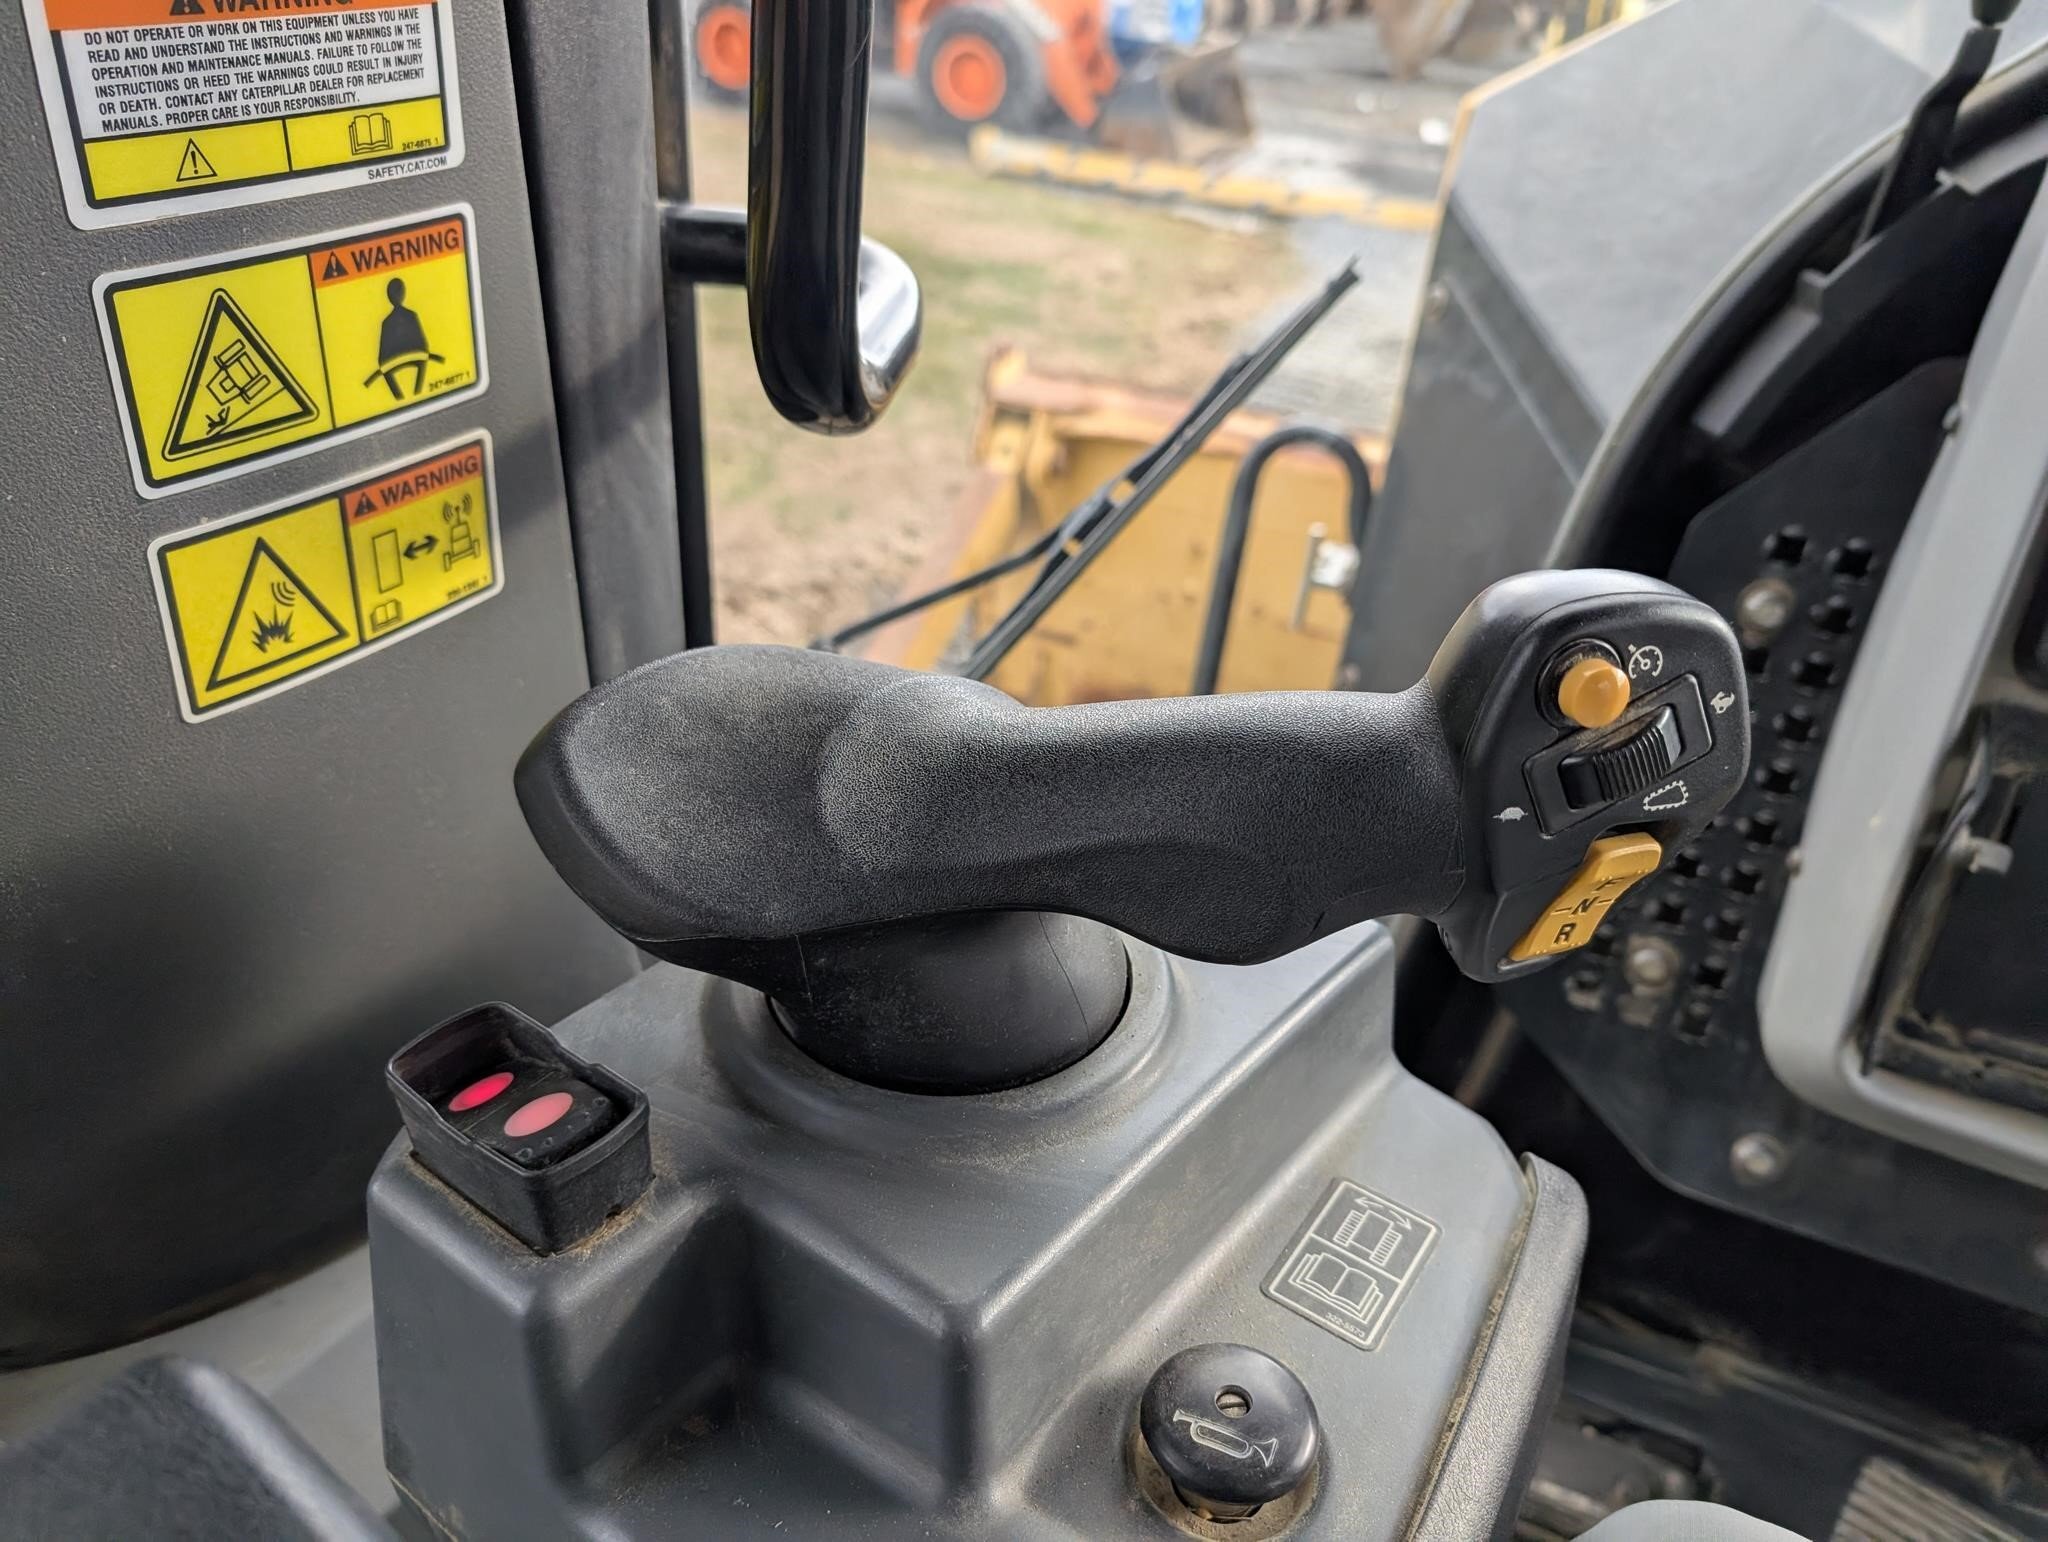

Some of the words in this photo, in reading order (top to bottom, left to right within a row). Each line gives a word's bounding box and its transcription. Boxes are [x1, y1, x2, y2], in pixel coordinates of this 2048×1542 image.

[84, 32, 102, 45] DO
[106, 30, 129, 44] NOT
[134, 26, 185, 42] OPERATE
[189, 25, 203, 38] OR
[207, 22, 240, 36] WORK
[242, 20, 257, 34] ON
[260, 20, 283, 32] THIS
[286, 14, 339, 30] EQUIPMENT
[342, 12, 376, 26] UNLESS
[378, 10, 396, 23] YOU
[398, 8, 419, 21] HAVE
[88, 49, 120, 63] READ
[124, 47, 148, 60] AND
[152, 41, 225, 58] UNDERSTAND
[228, 39, 248, 51] THE
[251, 33, 321, 50] INSTRUCTIONS
[324, 30, 343, 43] AND
[345, 26, 392, 41] WARNINGS
[395, 25, 403, 36] IN
[405, 23, 421, 35] THE
[91, 64, 158, 81] OPERATION
[161, 61, 184, 75] AND
[188, 54, 261, 72] MAINTENANCE
[264, 50, 314, 65] MANUALS.
[317, 45, 354, 60] FAILURE
[357, 44, 368, 55] TO
[371, 41, 404, 54] FOLLOW
[407, 38, 422, 50] THE
[95, 79, 179, 98] INSTRUCTIONS
[184, 77, 199, 90] OR
[203, 74, 230, 88] HEED
[234, 71, 253, 84] THE
[257, 66, 310, 82] WARNINGS
[313, 62, 343, 76] COULD
[347, 58, 379, 72] RESULT
[383, 57, 392, 68] IN
[394, 53, 423, 66] INJURY
[98, 102, 116, 116] OR
[120, 99, 162, 114] DEATH.
[165, 91, 214, 109] CONTACT
[218, 89, 238, 103] ANY
[242, 83, 307, 100] CATERPILLAR
[309, 78, 344, 92] DEALER
[347, 75, 364, 88] FOR
[367, 68, 424, 85] REPLACEMENT
[102, 115, 163, 133] MANUALS.
[165, 109, 209, 126] PROPER
[211, 106, 238, 120] CARE
[241, 104, 251, 117] IS
[254, 101, 281, 115] YOUR
[284, 91, 360, 111] RESPONSIBILITY.
[367, 156, 447, 180] SAFETY.CAT.COM
[350, 228, 460, 273] WARNING
[380, 456, 479, 506] WARNING
[1571, 896, 1599, 915] N
[1554, 923, 1577, 944] R
